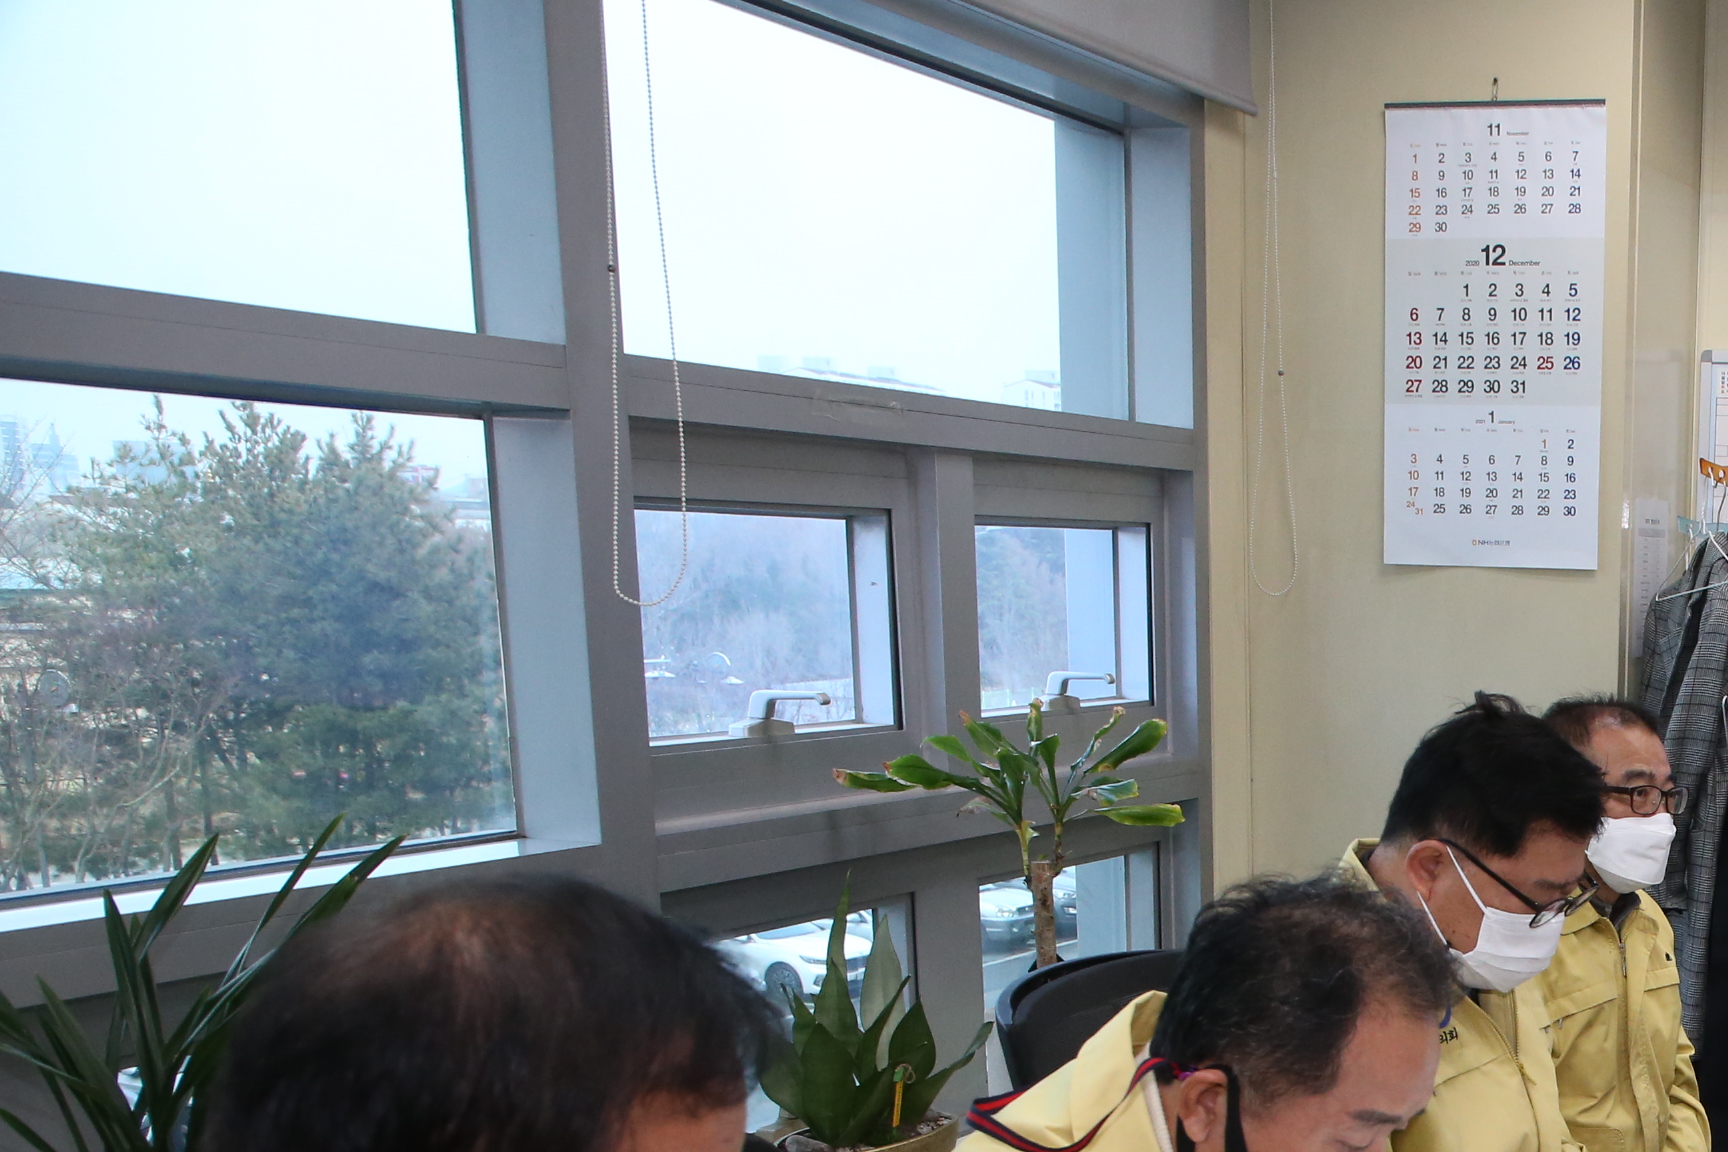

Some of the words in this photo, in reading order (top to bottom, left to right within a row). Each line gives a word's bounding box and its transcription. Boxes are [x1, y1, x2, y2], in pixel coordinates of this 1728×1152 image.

[1487, 122, 1501, 137] 11
[1411, 170, 1419, 182] 8
[1437, 169, 1446, 182] 9
[1461, 168, 1474, 181] 10
[1487, 168, 1499, 181] 11
[1514, 168, 1527, 180] 12
[1542, 167, 1555, 180] 13
[1569, 167, 1582, 180] 14
[1408, 187, 1421, 199] 15
[1435, 186, 1448, 199] 16
[1461, 185, 1474, 198] 17
[1487, 185, 1500, 198] 18
[1514, 185, 1527, 197] 19
[1540, 185, 1555, 197] 20
[1569, 185, 1581, 197] 21
[1407, 204, 1422, 217] 22
[1434, 204, 1448, 216] 23
[1460, 203, 1474, 216] 24
[1486, 202, 1501, 215] 25
[1513, 202, 1527, 215] 26
[1540, 202, 1554, 215] 27
[1567, 202, 1582, 215] 28
[1408, 221, 1422, 233] 29
[1434, 221, 1448, 233] 30
[1480, 243, 1507, 267] 12
[1508, 259, 1541, 267] December
[1462, 282, 1472, 298] 1
[1488, 282, 1498, 298] 2
[1514, 282, 1525, 298] 3
[1541, 282, 1552, 298] 4
[1568, 282, 1578, 298] 5
[1409, 307, 1419, 322] 6
[1436, 307, 1445, 322] 7
[1461, 306, 1472, 322] 8
[1487, 306, 1498, 322] 9
[1510, 306, 1528, 322] 10
[1537, 307, 1553, 322] 11
[1564, 306, 1581, 322] 12
[1405, 331, 1423, 346] 13
[1432, 331, 1449, 346] 14
[1457, 331, 1475, 346] 15
[1484, 330, 1501, 346] 16
[1510, 331, 1527, 346] 17
[1537, 331, 1554, 347] 18
[1563, 331, 1581, 347] 19
[1405, 354, 1423, 370] 20
[1432, 354, 1448, 370] 21
[1456, 354, 1475, 370] 22
[1483, 354, 1501, 370] 23
[1510, 355, 1528, 370] 24
[1536, 355, 1555, 371] 25
[1563, 355, 1581, 371] 26
[1405, 378, 1423, 393] 27
[1431, 378, 1449, 394] 28
[1457, 378, 1475, 394] 29
[1483, 379, 1501, 394] 30
[1510, 379, 1526, 394] 31
[1488, 410, 1495, 424] 1
[1407, 469, 1420, 481] 10
[1434, 470, 1445, 481] 11
[1459, 470, 1472, 483] 12
[1485, 470, 1498, 482] 13
[1511, 471, 1524, 483] 14
[1538, 471, 1550, 483] 15
[1564, 472, 1577, 484] 16
